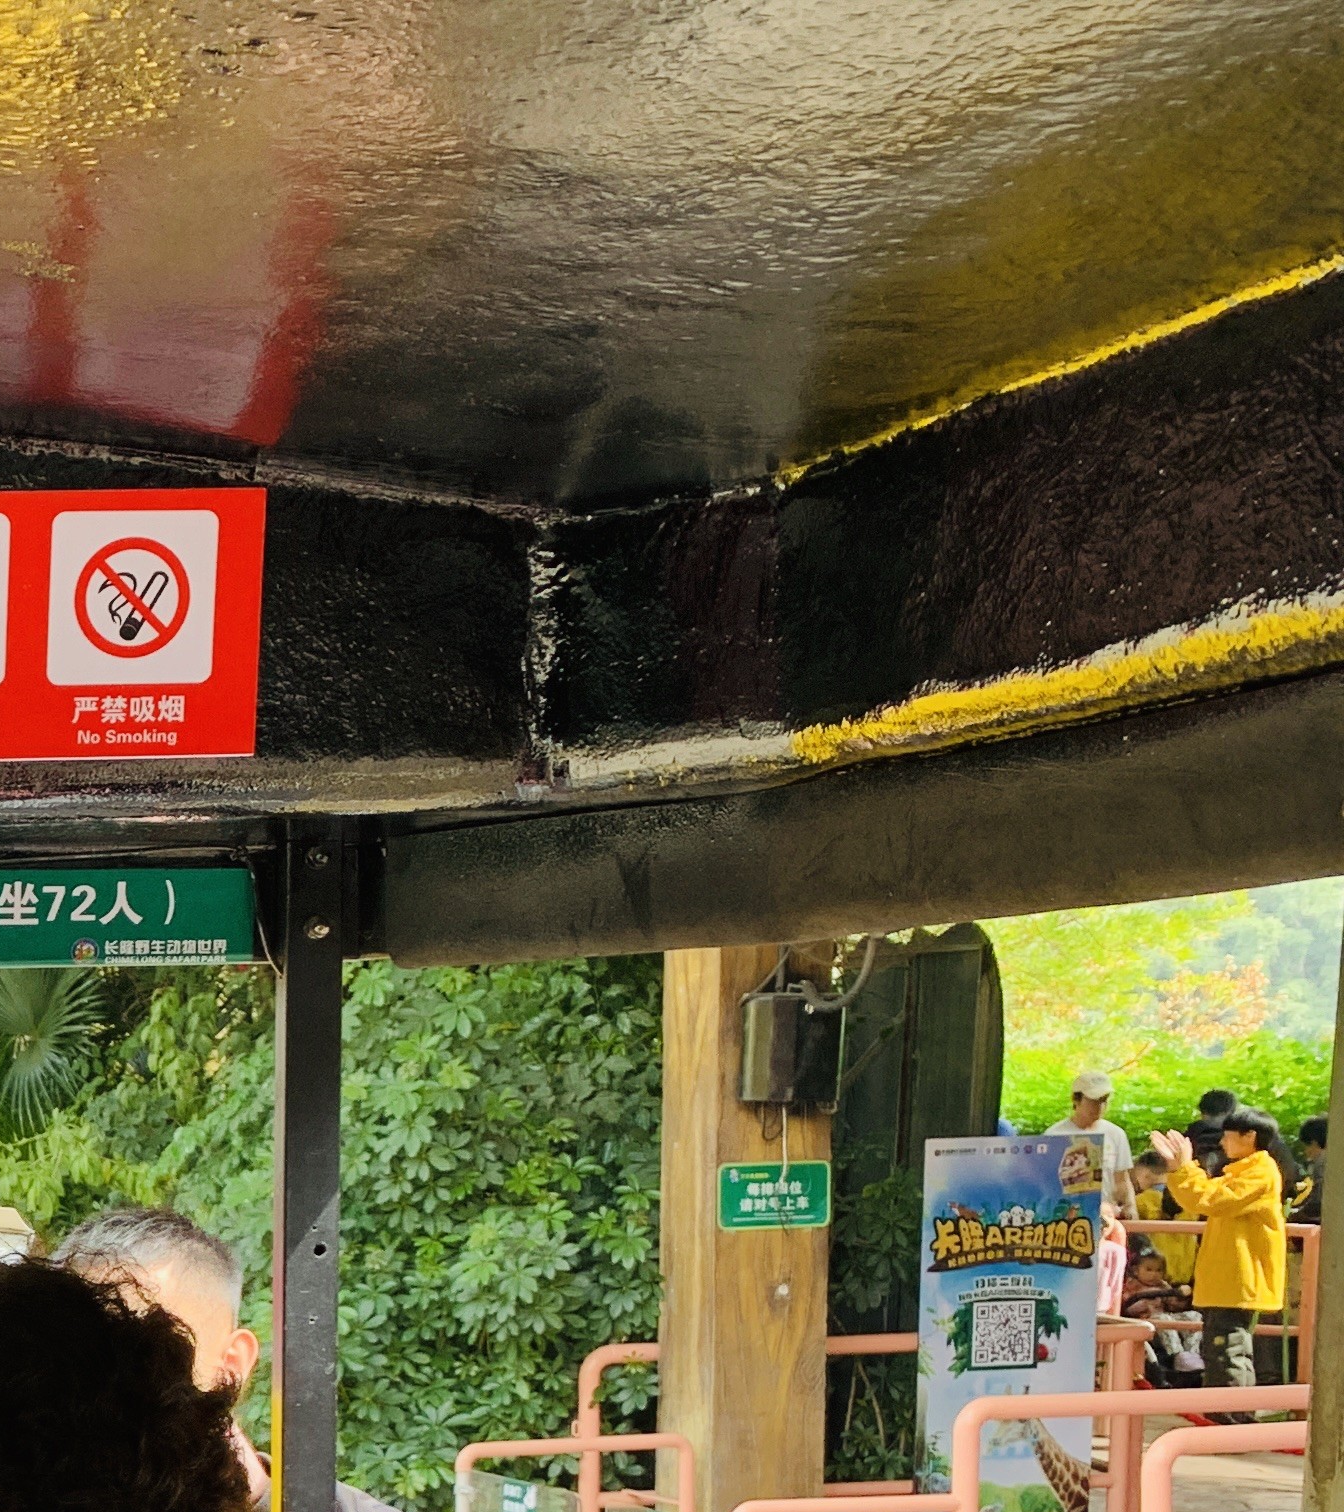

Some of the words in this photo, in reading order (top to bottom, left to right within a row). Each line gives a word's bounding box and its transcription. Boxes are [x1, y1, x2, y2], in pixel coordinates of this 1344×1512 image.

[71, 694, 185, 724] 严禁吸烟
[77, 730, 101, 745] No
[105, 729, 177, 746] Smoking
[104, 939, 227, 955] 长隆野生动物世界
